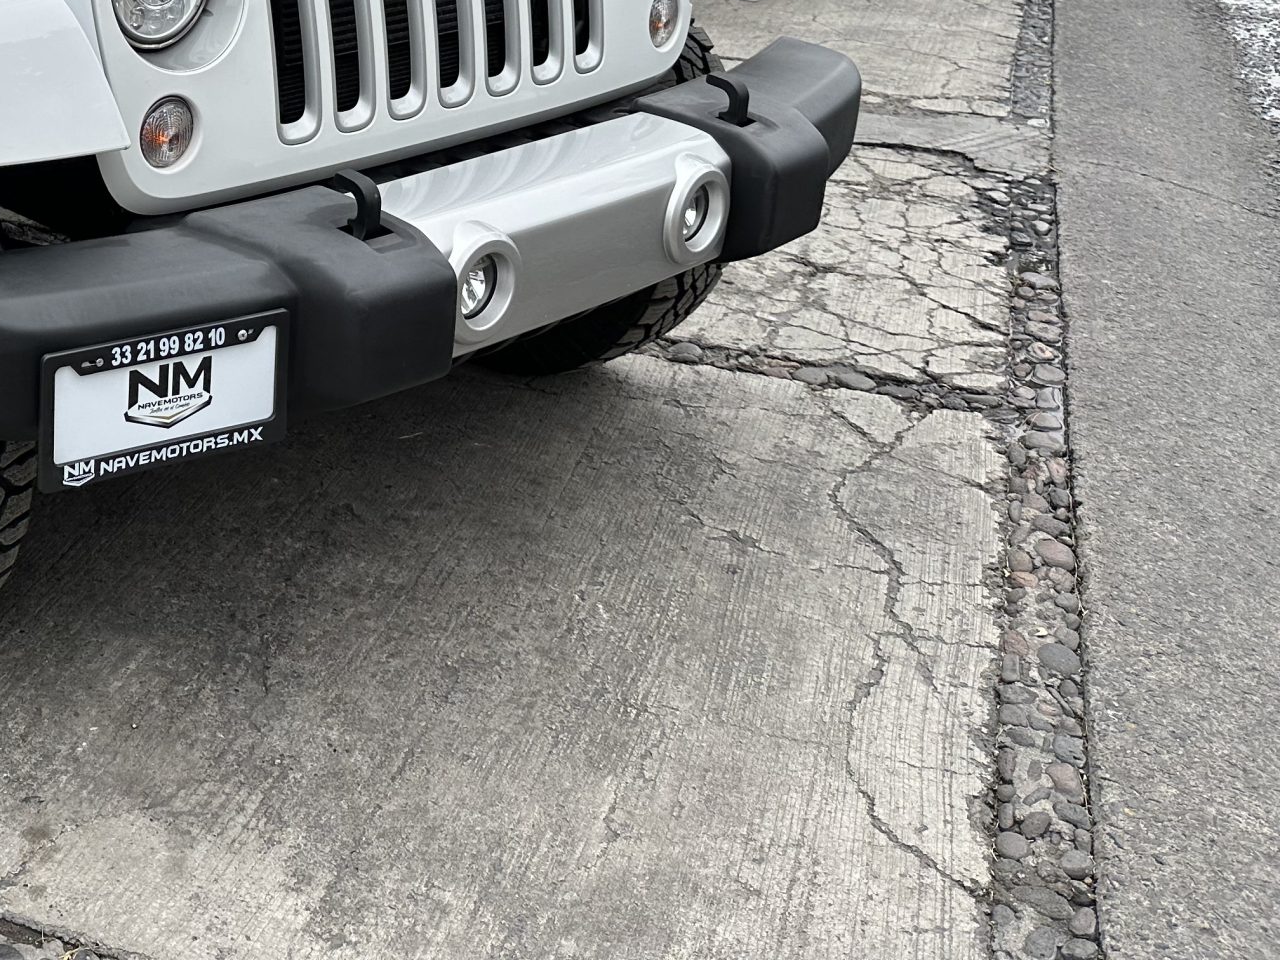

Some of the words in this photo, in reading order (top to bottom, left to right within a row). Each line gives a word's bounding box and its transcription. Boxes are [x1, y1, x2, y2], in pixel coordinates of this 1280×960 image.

[111, 344, 132, 366] 33
[136, 340, 155, 361] 21
[159, 335, 180, 357] 99
[184, 331, 204, 352] 82
[208, 327, 226, 347] 10
[127, 355, 213, 411] NM
[137, 392, 204, 411] NAVEMOTORS
[63, 459, 95, 481] NM
[99, 426, 264, 477] NAVEMOTORS.MX
